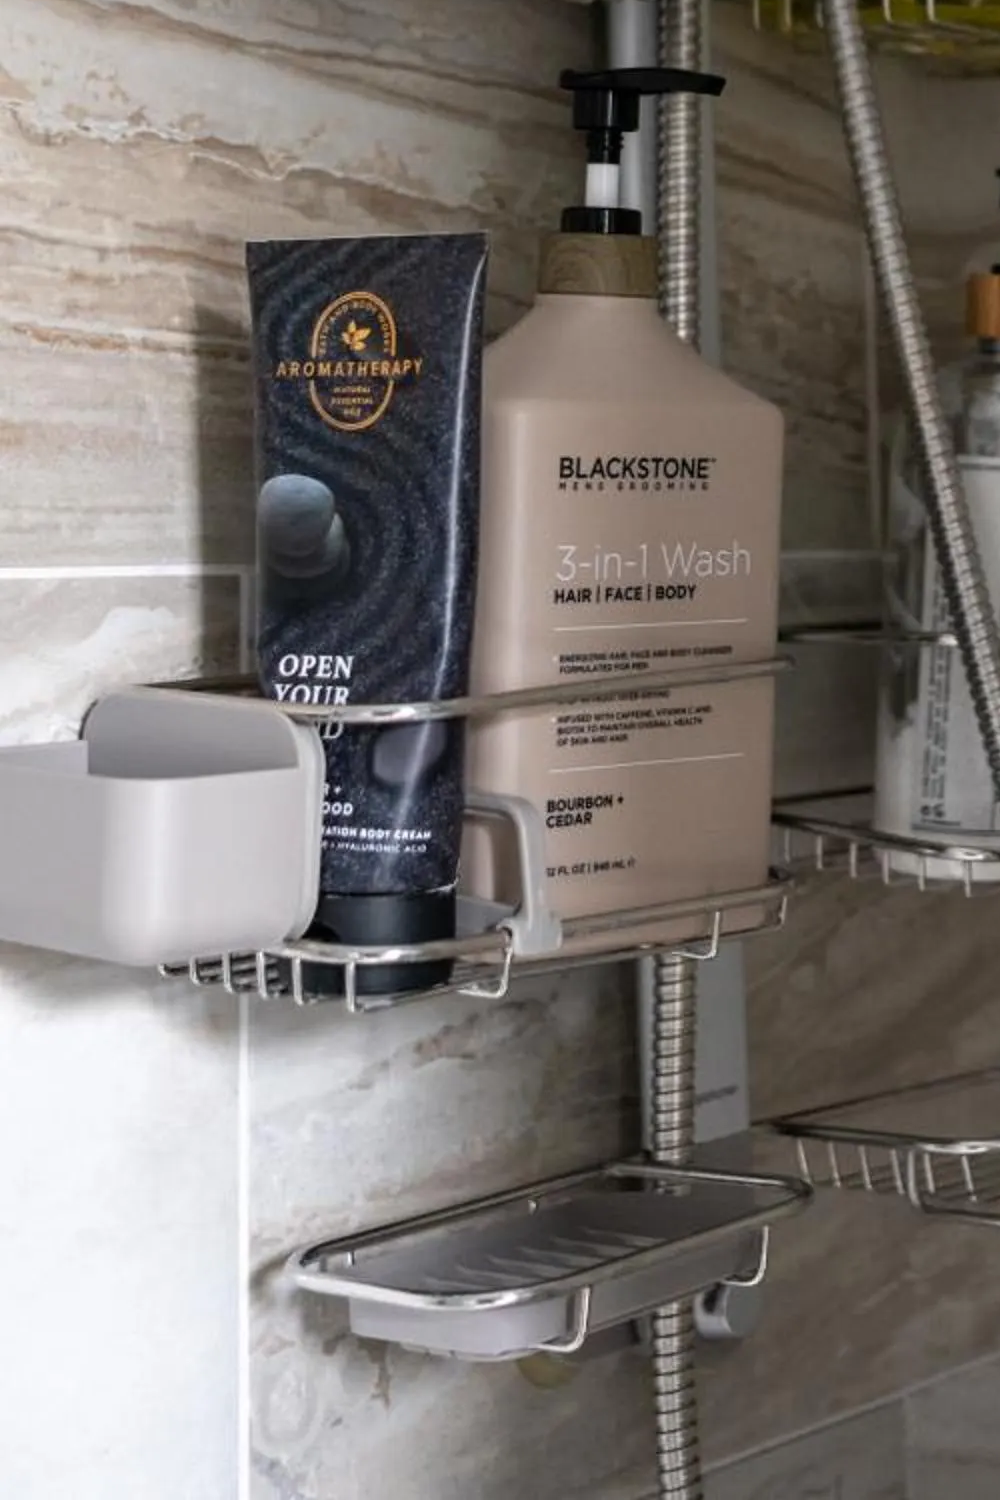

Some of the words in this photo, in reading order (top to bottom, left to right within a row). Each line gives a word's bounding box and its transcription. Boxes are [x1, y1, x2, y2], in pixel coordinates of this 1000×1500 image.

[276, 356, 423, 378] AROMATHERAPY
[616, 481, 710, 492] GROOMING
[556, 544, 648, 581] 3-in-1
[661, 539, 751, 577] Wash
[553, 588, 593, 604] HAIR
[604, 586, 643, 602] FACE
[655, 585, 697, 601] BODY
[279, 654, 354, 679] OPEN
[547, 794, 613, 813] BOURBON
[546, 811, 593, 829] CEDAR
[359, 827, 392, 840] BODY
[394, 828, 432, 841] CREAM
